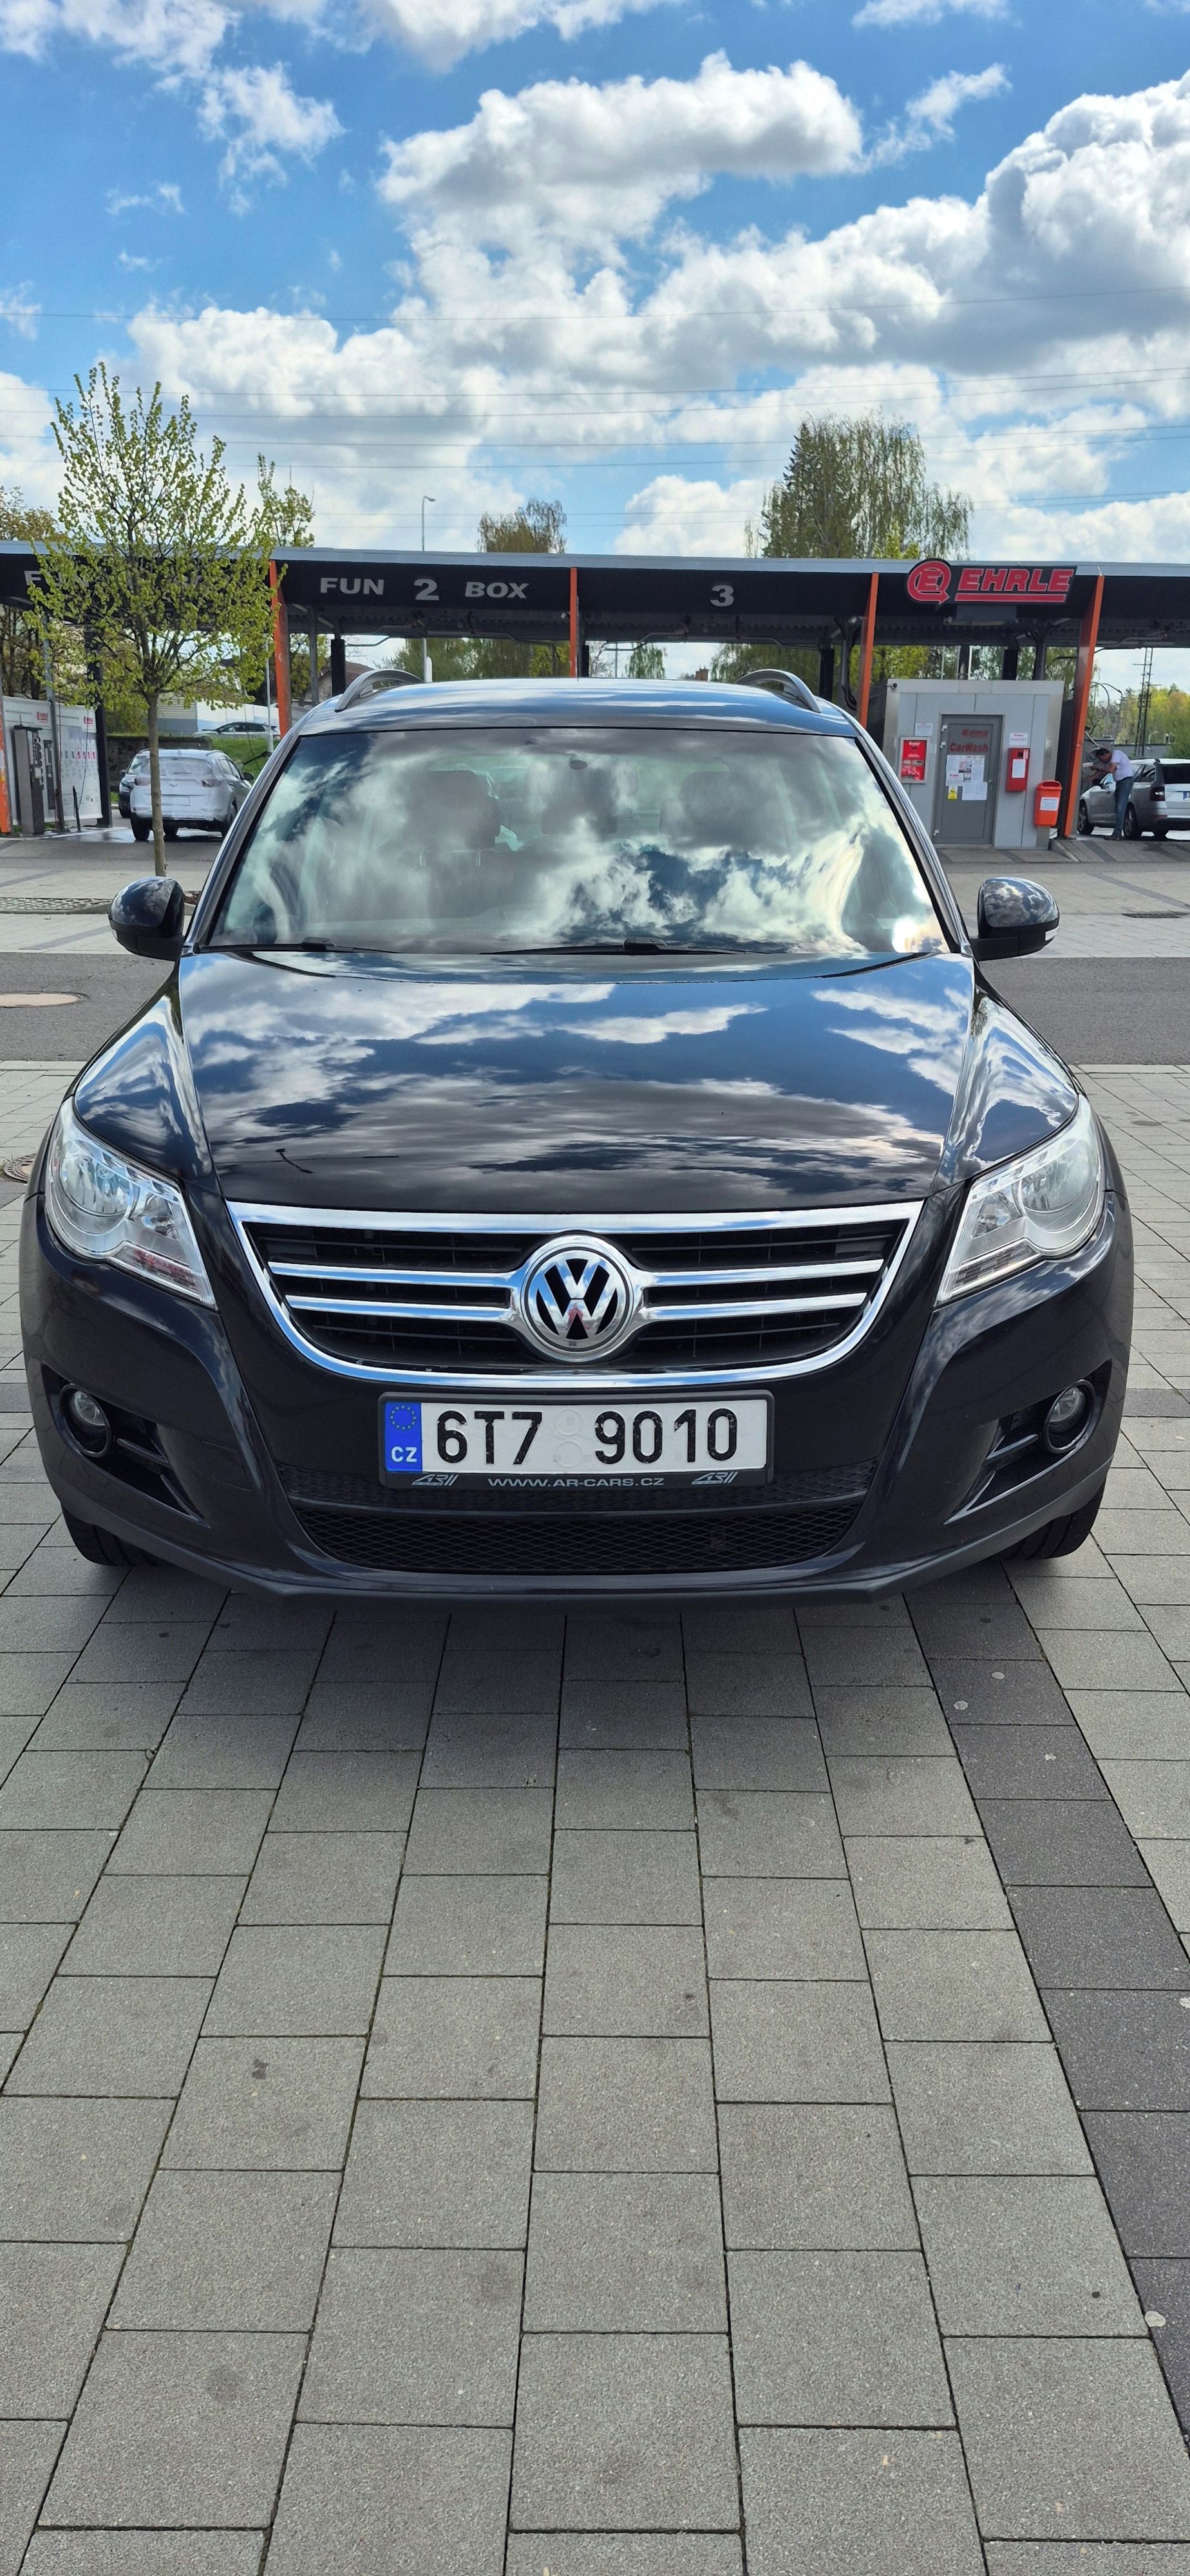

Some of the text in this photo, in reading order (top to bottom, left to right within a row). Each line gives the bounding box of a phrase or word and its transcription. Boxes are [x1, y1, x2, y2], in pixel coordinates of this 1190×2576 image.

[320, 578, 530, 601] FUN 2 BOX
[957, 568, 1075, 592] EHRLE
[710, 584, 734, 607] 3
[949, 742, 989, 753] CarWash
[529, 1249, 626, 1348] VW
[437, 1408, 738, 1465] 6T7 9010
[391, 1446, 418, 1463] CZ
[487, 1477, 665, 1488] WWW.AR-CARS.CZ
